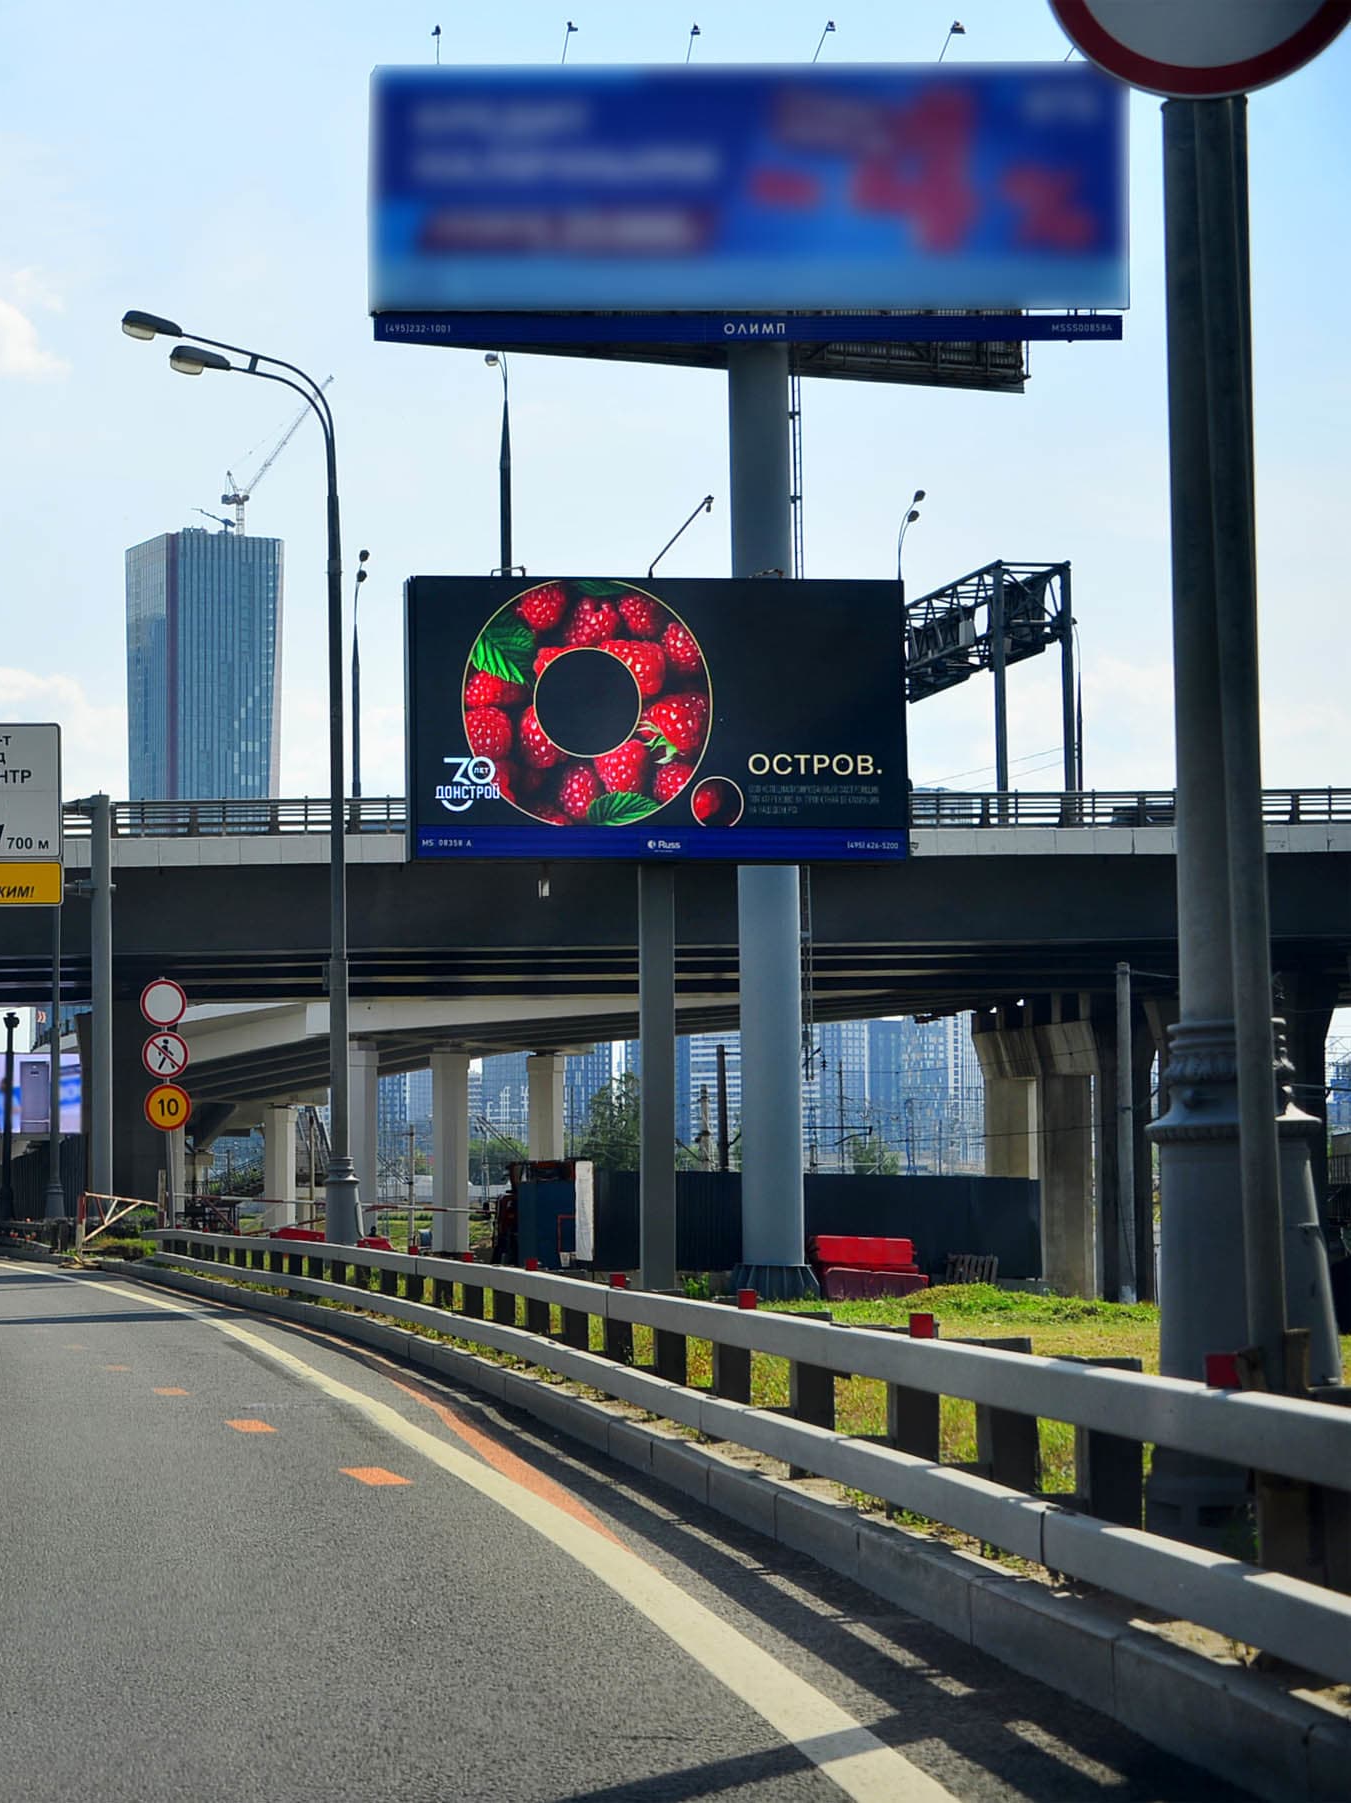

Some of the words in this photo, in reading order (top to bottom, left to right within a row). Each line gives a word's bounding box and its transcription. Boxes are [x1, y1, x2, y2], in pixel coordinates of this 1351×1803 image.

[723, 322, 786, 335] ОЛИМП
[748, 753, 883, 775] ОСТРОВ.
[435, 782, 500, 799] ДОНСТРОЙ
[6, 837, 33, 849] 700
[38, 839, 49, 849] м
[157, 1098, 179, 1117] 10
